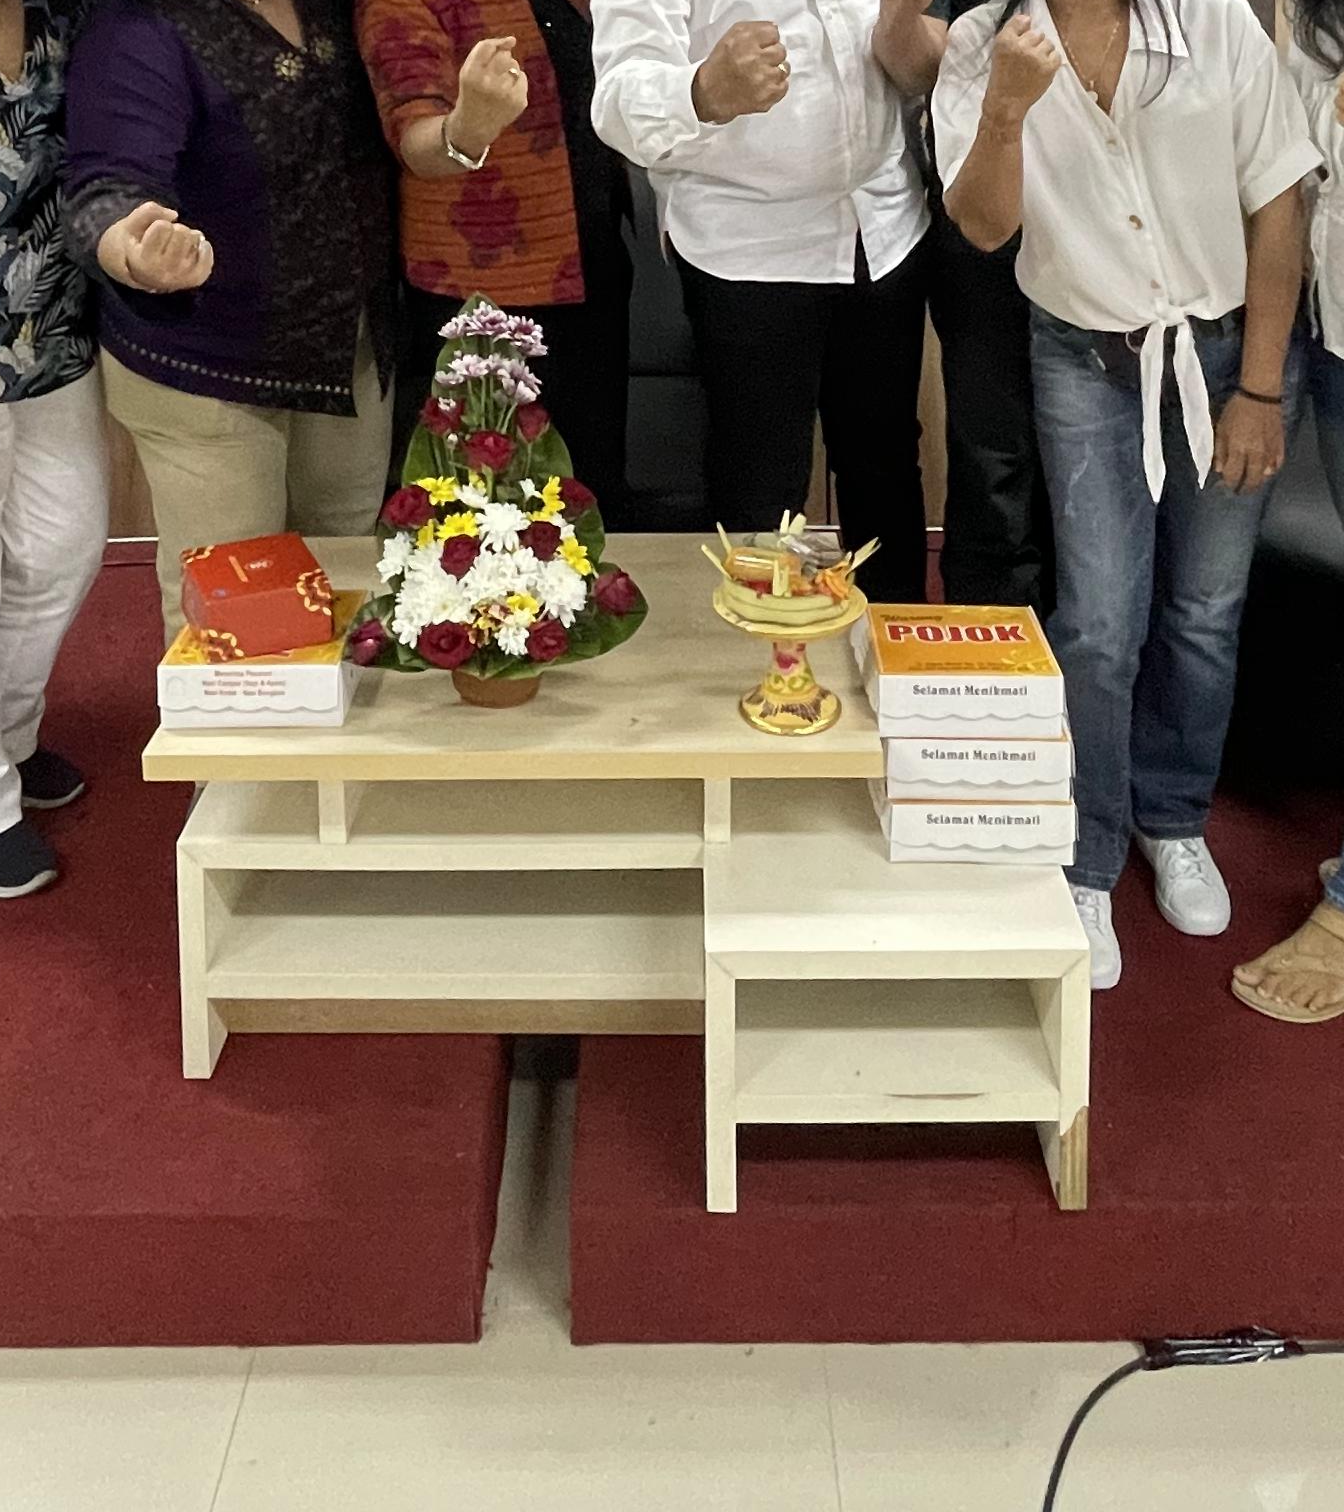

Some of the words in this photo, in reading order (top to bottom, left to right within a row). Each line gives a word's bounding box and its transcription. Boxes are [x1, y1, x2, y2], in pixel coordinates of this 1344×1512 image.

[912, 684, 961, 696] Selamat
[964, 685, 1028, 697] Menikmati
[921, 748, 969, 760] Selamat
[973, 750, 1036, 761] Menikmati
[926, 814, 974, 826] Selamat
[978, 814, 1040, 826] Menikmati
